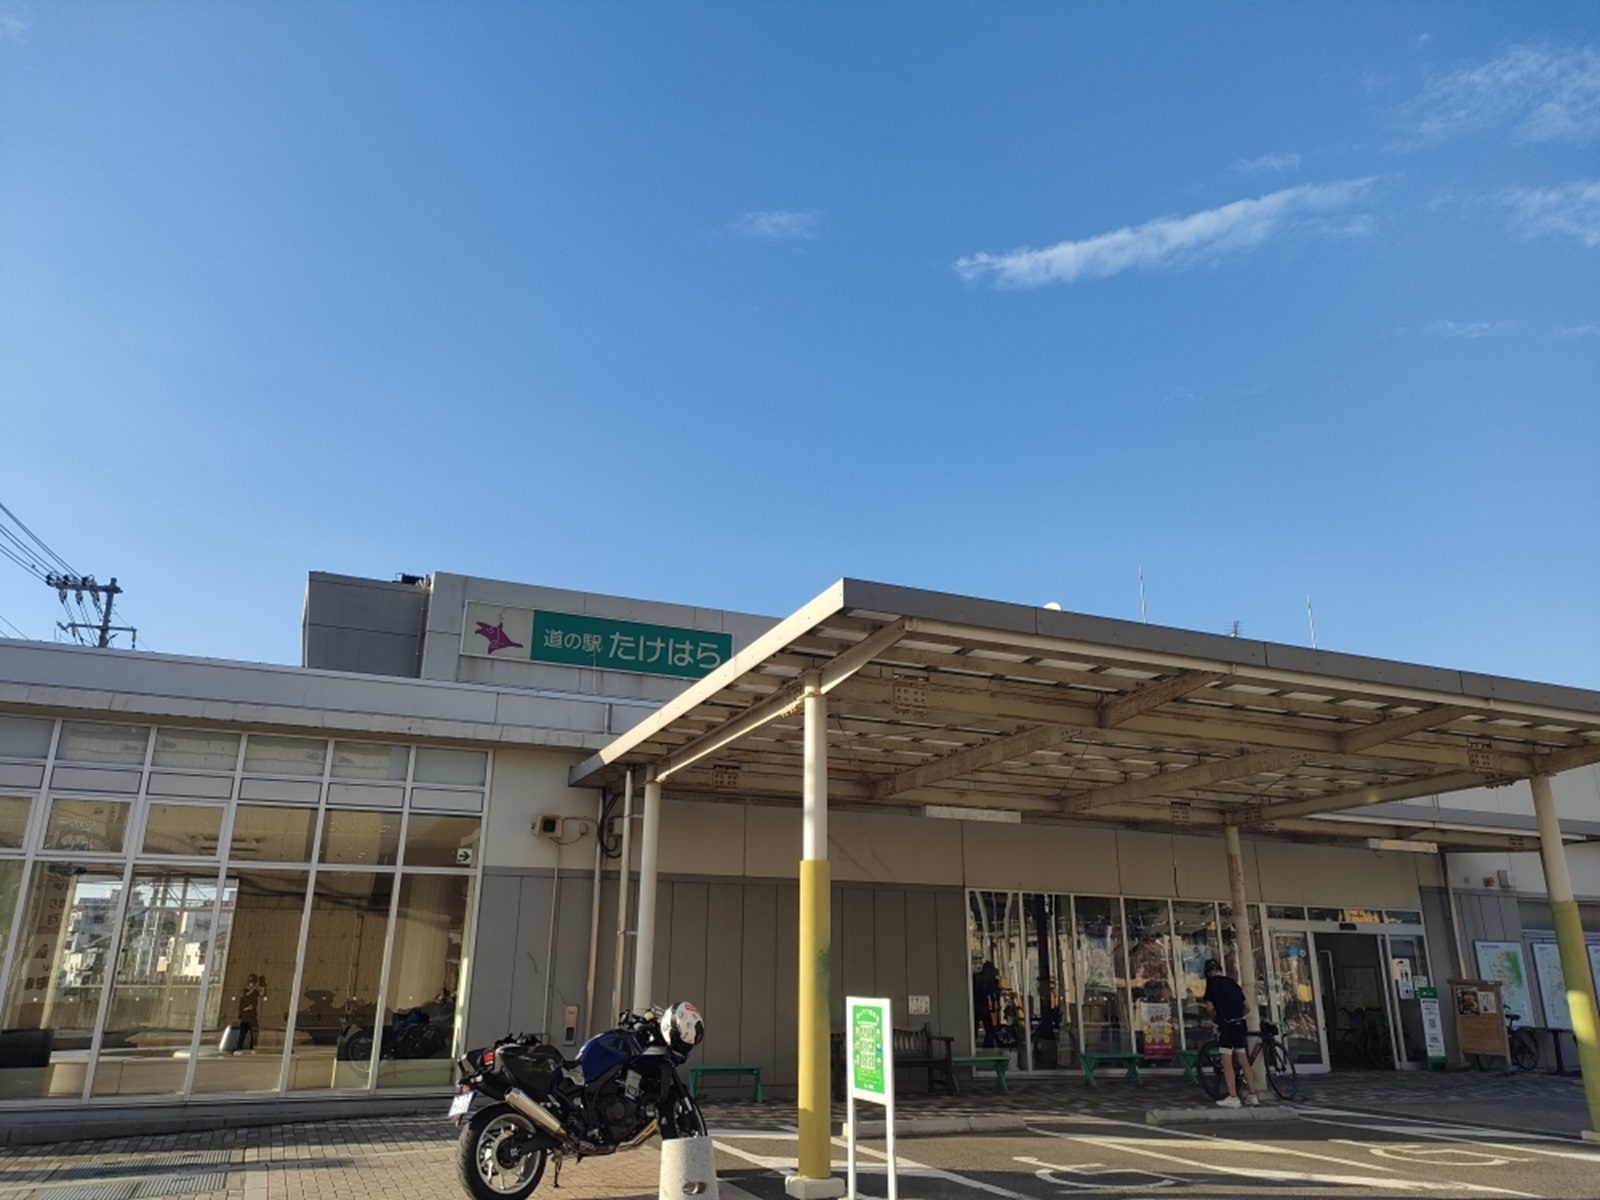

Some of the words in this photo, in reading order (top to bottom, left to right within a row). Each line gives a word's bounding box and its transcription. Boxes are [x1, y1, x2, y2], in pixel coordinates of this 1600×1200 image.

[543, 628, 602, 653] 道の駅
[608, 631, 722, 669] たけはら
